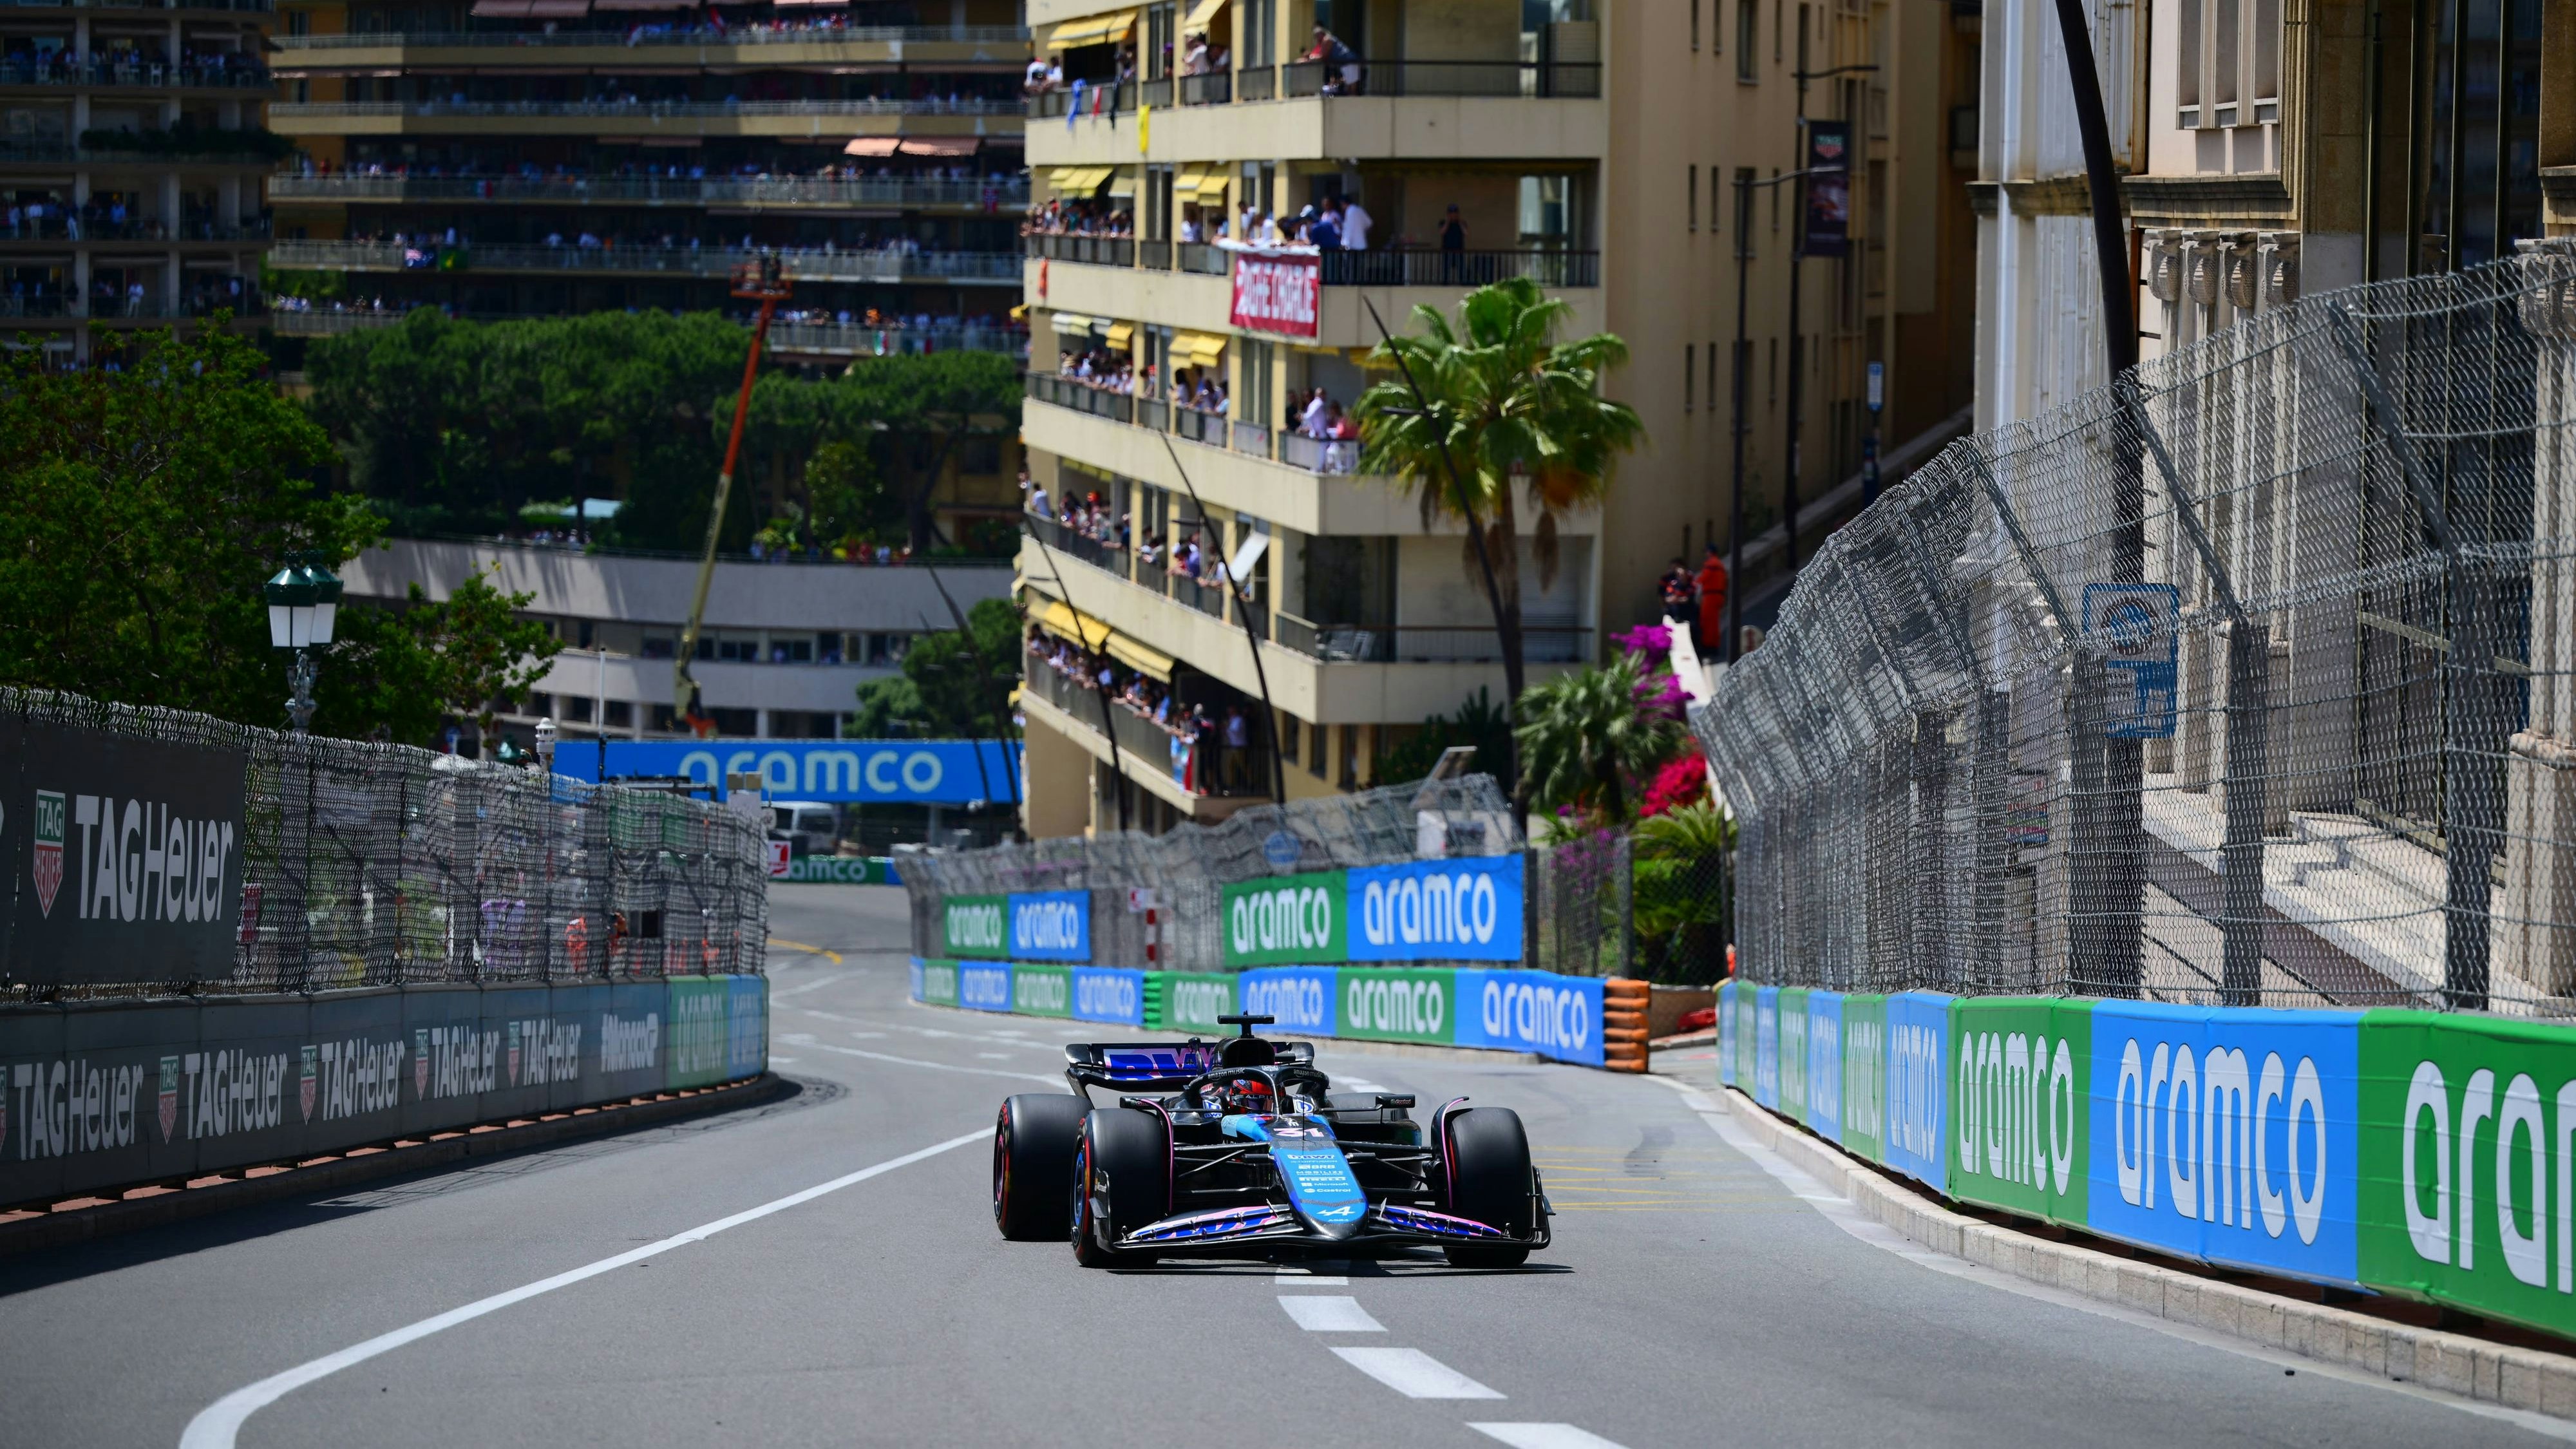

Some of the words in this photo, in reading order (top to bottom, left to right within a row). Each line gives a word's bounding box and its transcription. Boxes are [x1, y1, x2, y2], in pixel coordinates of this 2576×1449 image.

[678, 750, 943, 793] aramco
[39, 799, 62, 837] TAG
[35, 849, 62, 907] HEUER
[790, 860, 867, 880] amco
[947, 904, 1001, 947] aramco
[1016, 901, 1079, 949] aramco
[1233, 887, 1331, 954] aramco
[1364, 873, 1497, 945] aramco
[1077, 974, 1135, 1019] aramco
[1173, 979, 1231, 1024] aramco
[1247, 978, 1323, 1027] aramco
[1347, 978, 1444, 1034] aramco
[1483, 980, 1588, 1051] aramco
[162, 1064, 177, 1084] TAG
[303, 1052, 315, 1074] TAG
[1208, 1070, 1227, 1079] amazon
[1227, 1067, 1245, 1076] music
[1890, 1023, 1938, 1163] aramco
[1960, 1031, 2073, 1197] aramco
[1273, 1128, 1325, 1137] 31
[2116, 1037, 2326, 1245] aramco
